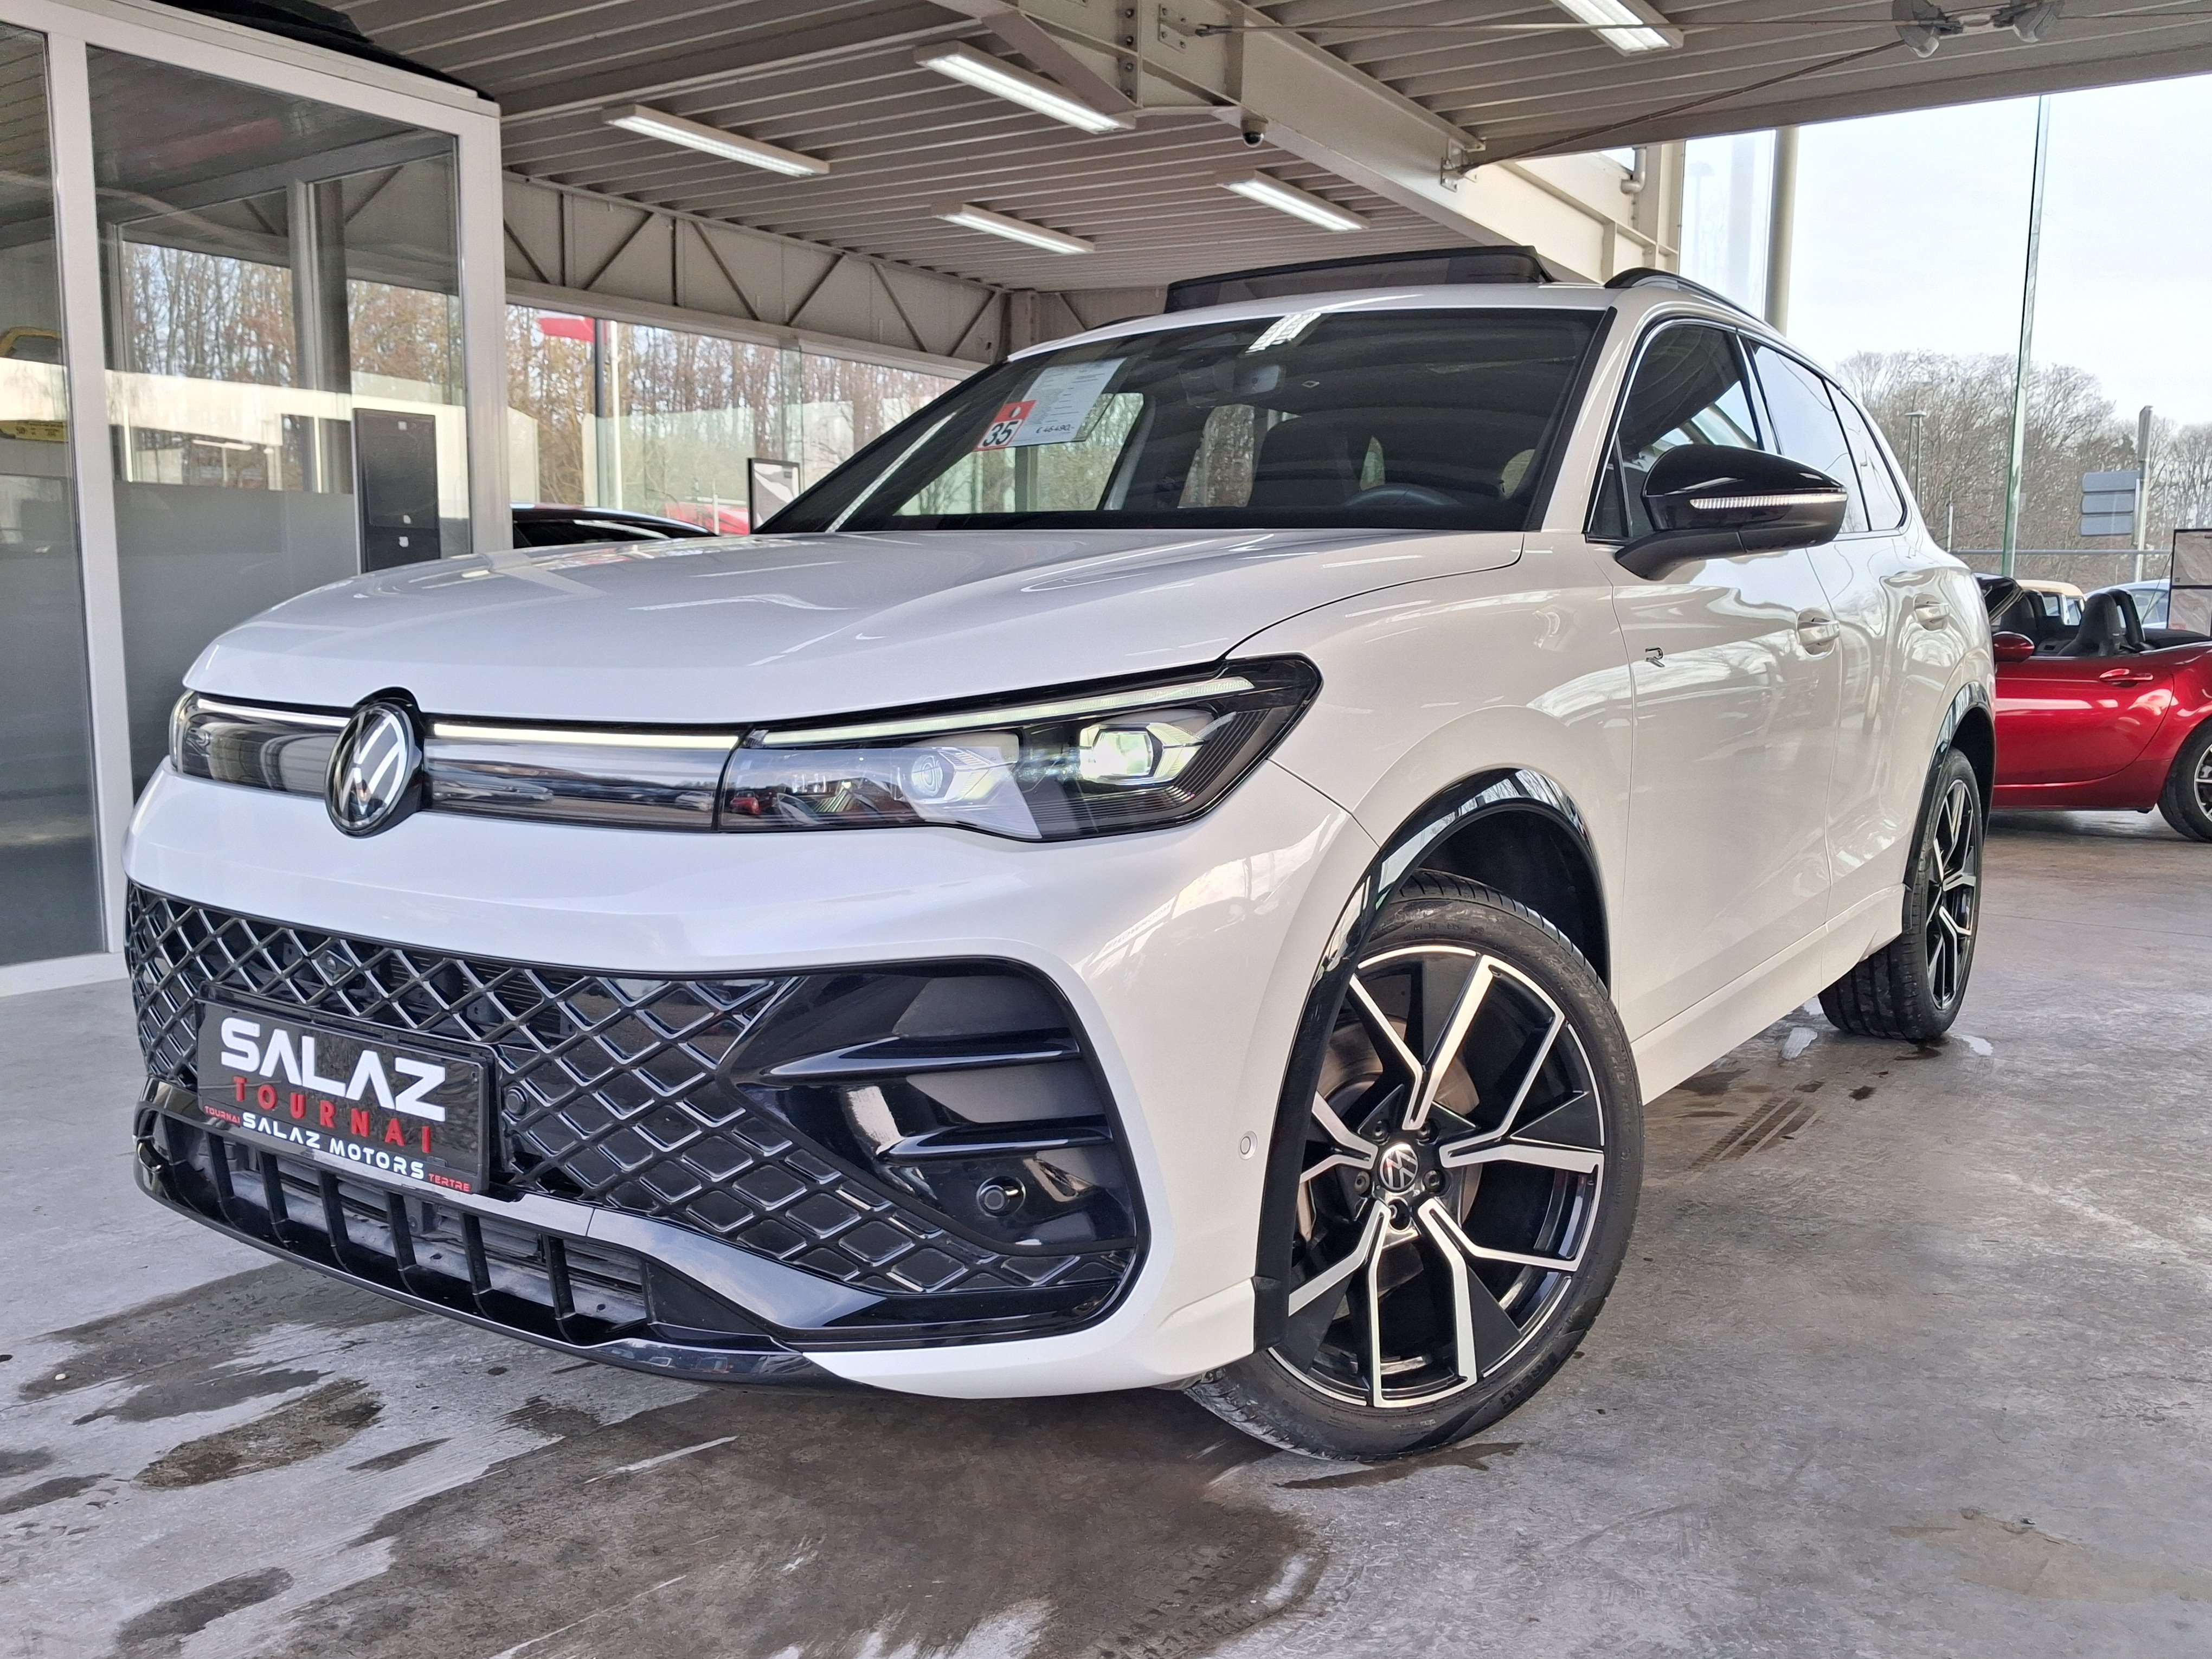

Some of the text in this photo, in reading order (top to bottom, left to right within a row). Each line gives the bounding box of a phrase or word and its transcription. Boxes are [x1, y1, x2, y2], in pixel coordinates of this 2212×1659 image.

[982, 421, 1018, 447] 35
[221, 1017, 446, 1122] SALAZ
[204, 1105, 472, 1192] TOURNAI SALAZ MOTORS TERTRE
[233, 1075, 432, 1154] TOURNAI
